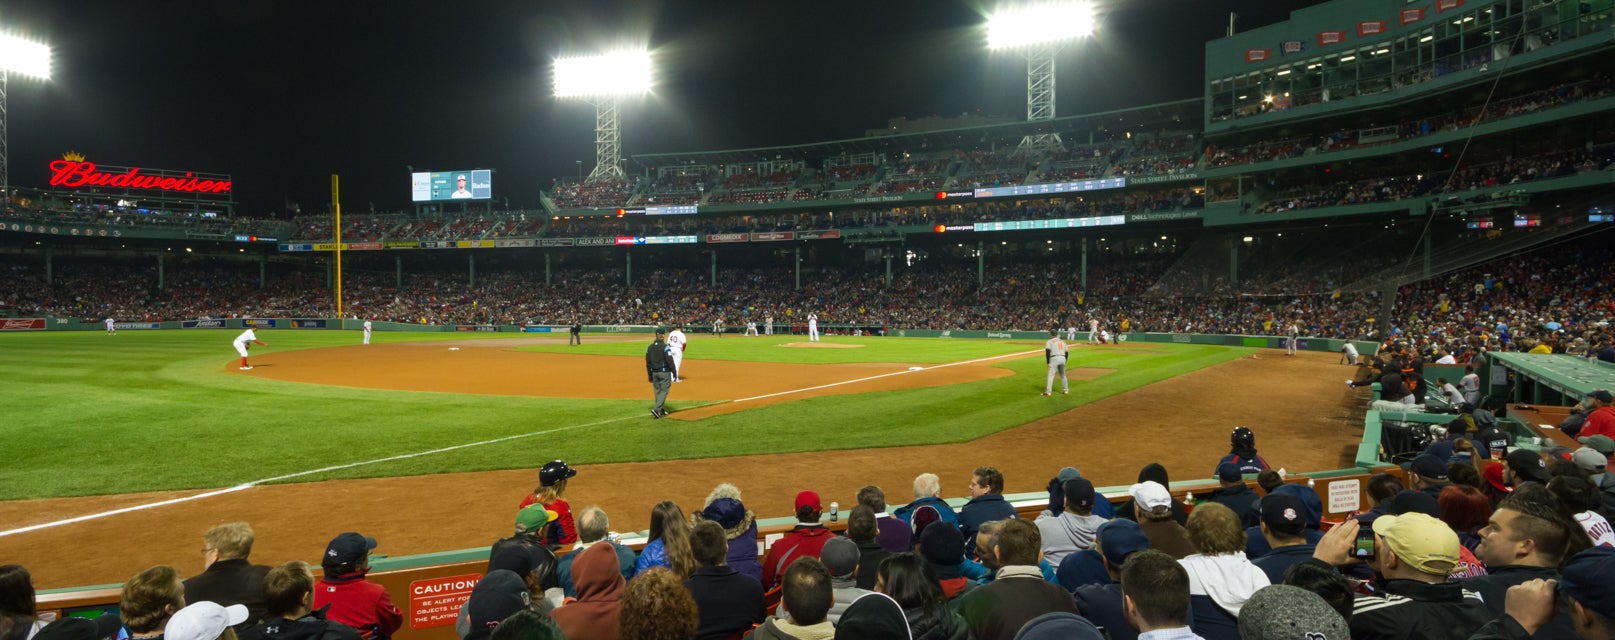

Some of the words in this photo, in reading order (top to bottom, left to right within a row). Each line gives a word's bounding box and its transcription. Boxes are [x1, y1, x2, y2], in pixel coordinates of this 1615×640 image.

[49, 160, 232, 193] Budweiser
[1588, 522, 1611, 540] ORTIZ
[416, 607, 448, 615] OBJECTS
